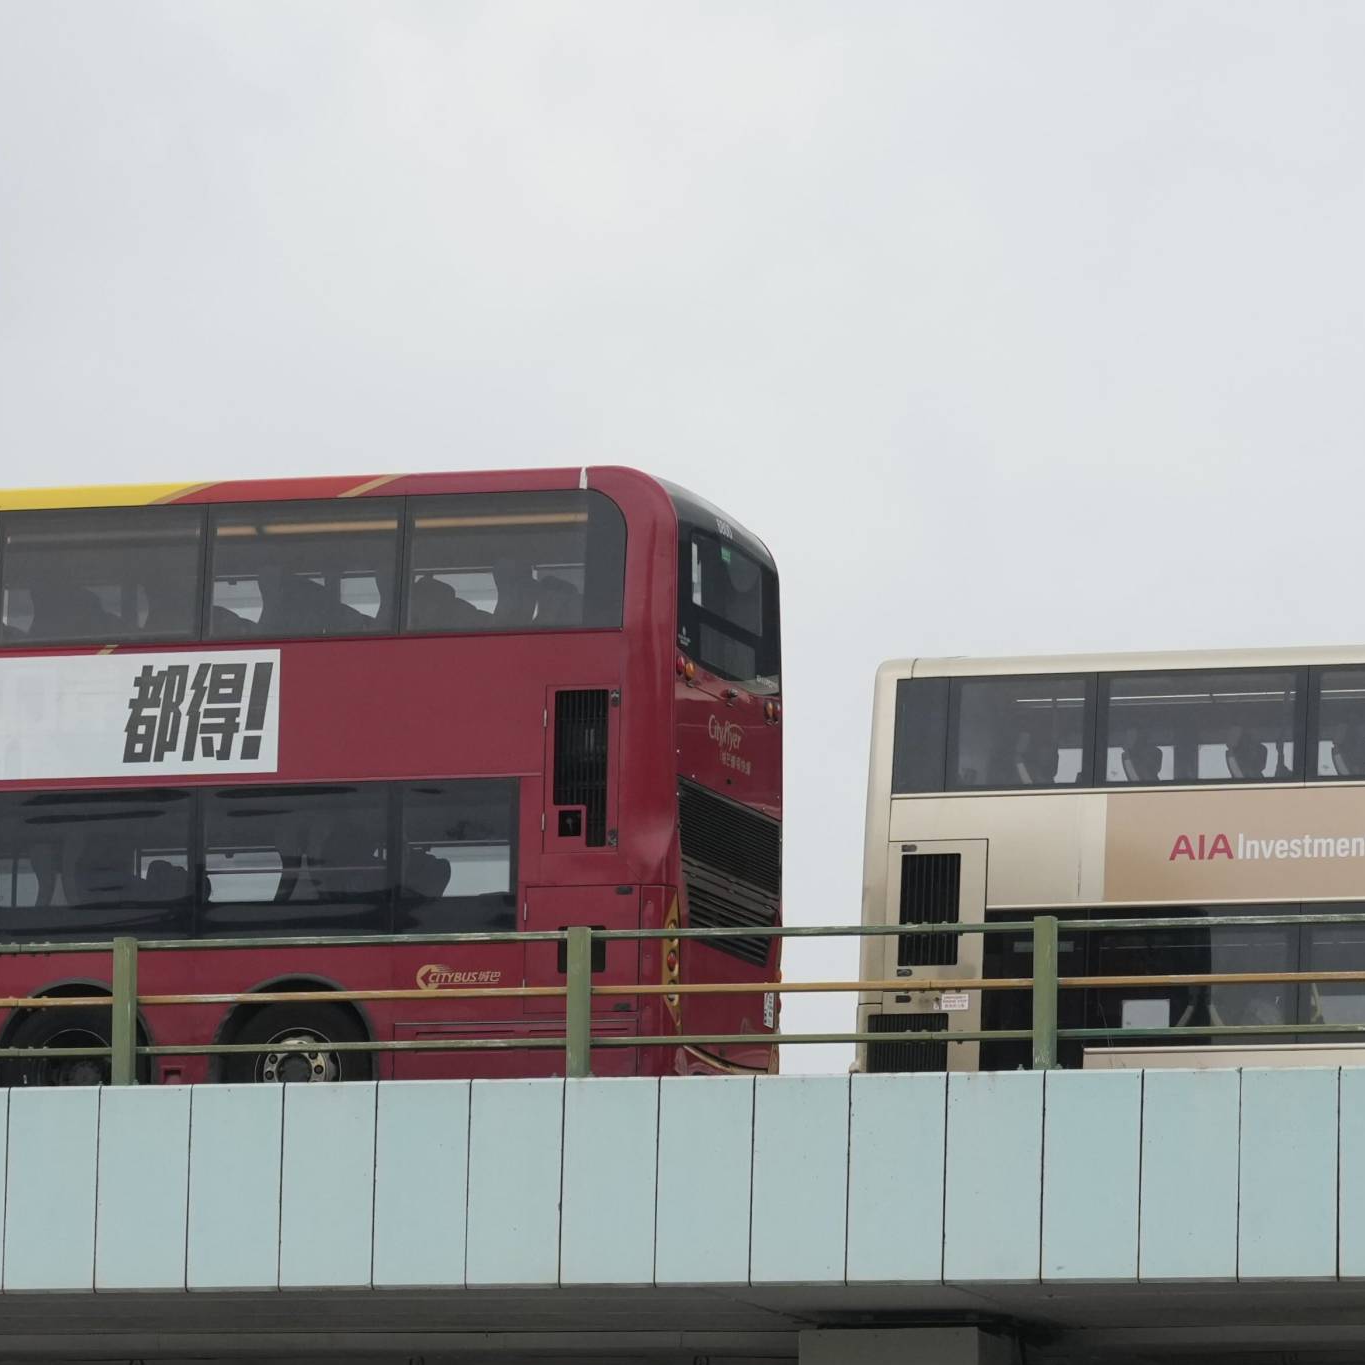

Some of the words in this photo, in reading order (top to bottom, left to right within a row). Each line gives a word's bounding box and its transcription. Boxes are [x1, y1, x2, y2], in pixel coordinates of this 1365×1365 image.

[122, 662, 272, 764] 都得!
[1169, 833, 1234, 861] AIA
[428, 971, 479, 984] CITYBUS
